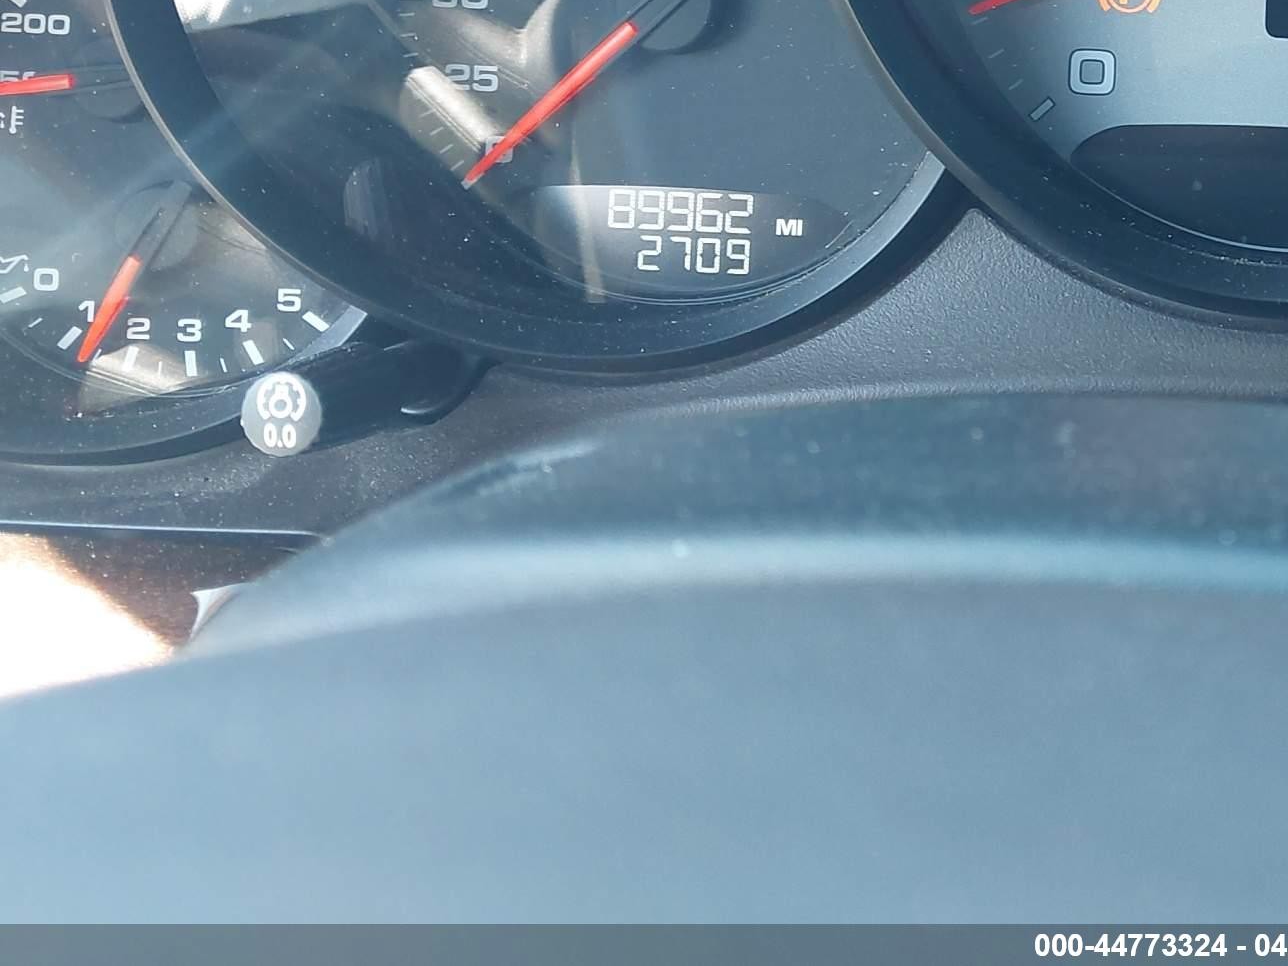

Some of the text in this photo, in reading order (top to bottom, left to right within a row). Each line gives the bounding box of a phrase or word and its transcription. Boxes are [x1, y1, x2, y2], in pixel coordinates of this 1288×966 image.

[1, 13, 70, 35] 200
[445, 64, 499, 92] 25
[1068, 48, 1117, 96] 0
[607, 189, 754, 232] 89962
[775, 216, 803, 236] MI
[636, 236, 751, 275] 2709
[33, 268, 60, 291] 0
[78, 300, 95, 323] 1
[277, 289, 301, 312] 5
[127, 318, 151, 340] 2
[177, 319, 202, 342] 3
[225, 309, 252, 333] 4
